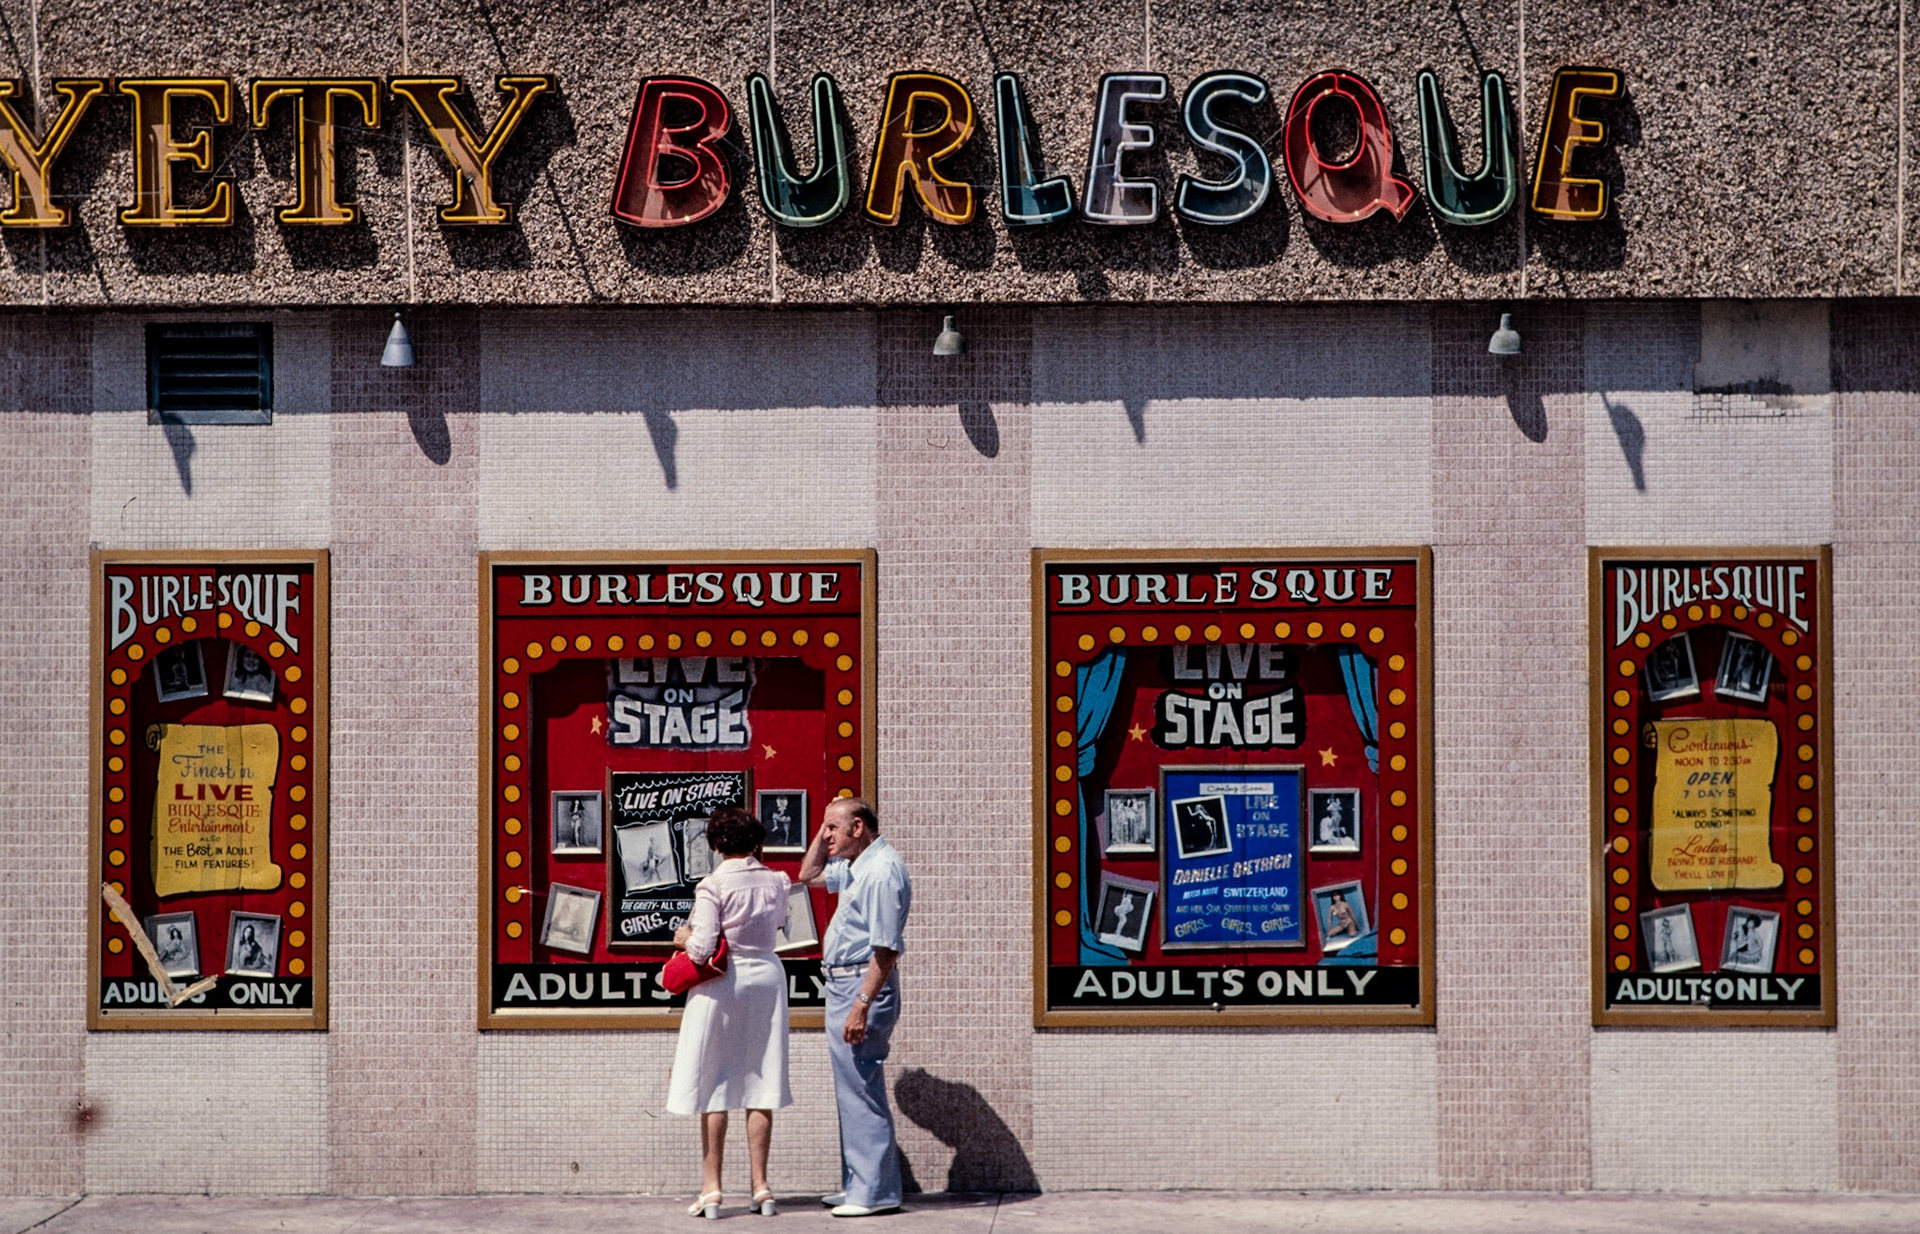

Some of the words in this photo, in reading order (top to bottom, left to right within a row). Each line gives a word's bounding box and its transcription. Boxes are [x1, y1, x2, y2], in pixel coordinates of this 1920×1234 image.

[612, 66, 1626, 229] BURLESQUE
[519, 572, 840, 607] BURLESQUE
[1058, 568, 1393, 604] BURLESQUE
[108, 573, 299, 654] BURLESQUE
[619, 656, 746, 683] LIVE
[1173, 643, 1286, 680] LIVE
[664, 688, 694, 703] ON
[1208, 682, 1242, 700] ON
[613, 689, 745, 744] STAGE
[1164, 688, 1296, 745] STAGE
[198, 745, 224, 754] THE
[172, 754, 235, 778] Finest
[1675, 757, 1704, 766] NOON
[1709, 757, 1720, 766] TO
[1687, 772, 1734, 785] OPEN
[174, 783, 254, 801] LIVE
[624, 792, 659, 810] LIVE
[661, 788, 683, 806] ON
[686, 781, 733, 801] STAGE
[1683, 789, 1690, 799] 7
[1698, 789, 1737, 798] DAYS
[1245, 795, 1279, 809] LIVE
[168, 804, 260, 819] BURLESQUE
[1253, 811, 1270, 821] ON
[168, 818, 255, 833] Entertainment
[1236, 823, 1290, 838] STAGE
[164, 847, 183, 856] THE
[186, 843, 213, 857] Best
[226, 845, 254, 856] ADULT
[175, 860, 198, 869] FILM
[1173, 864, 1229, 885] DANIELLE
[1233, 853, 1292, 878] DIETRICH
[1223, 887, 1288, 899] SWITZERLAND
[661, 901, 674, 910] ALL
[1073, 969, 1246, 999] ADULTS
[1257, 970, 1378, 997] ONLY
[1715, 978, 1804, 1000] ONLY
[229, 983, 302, 1005] ONLY
